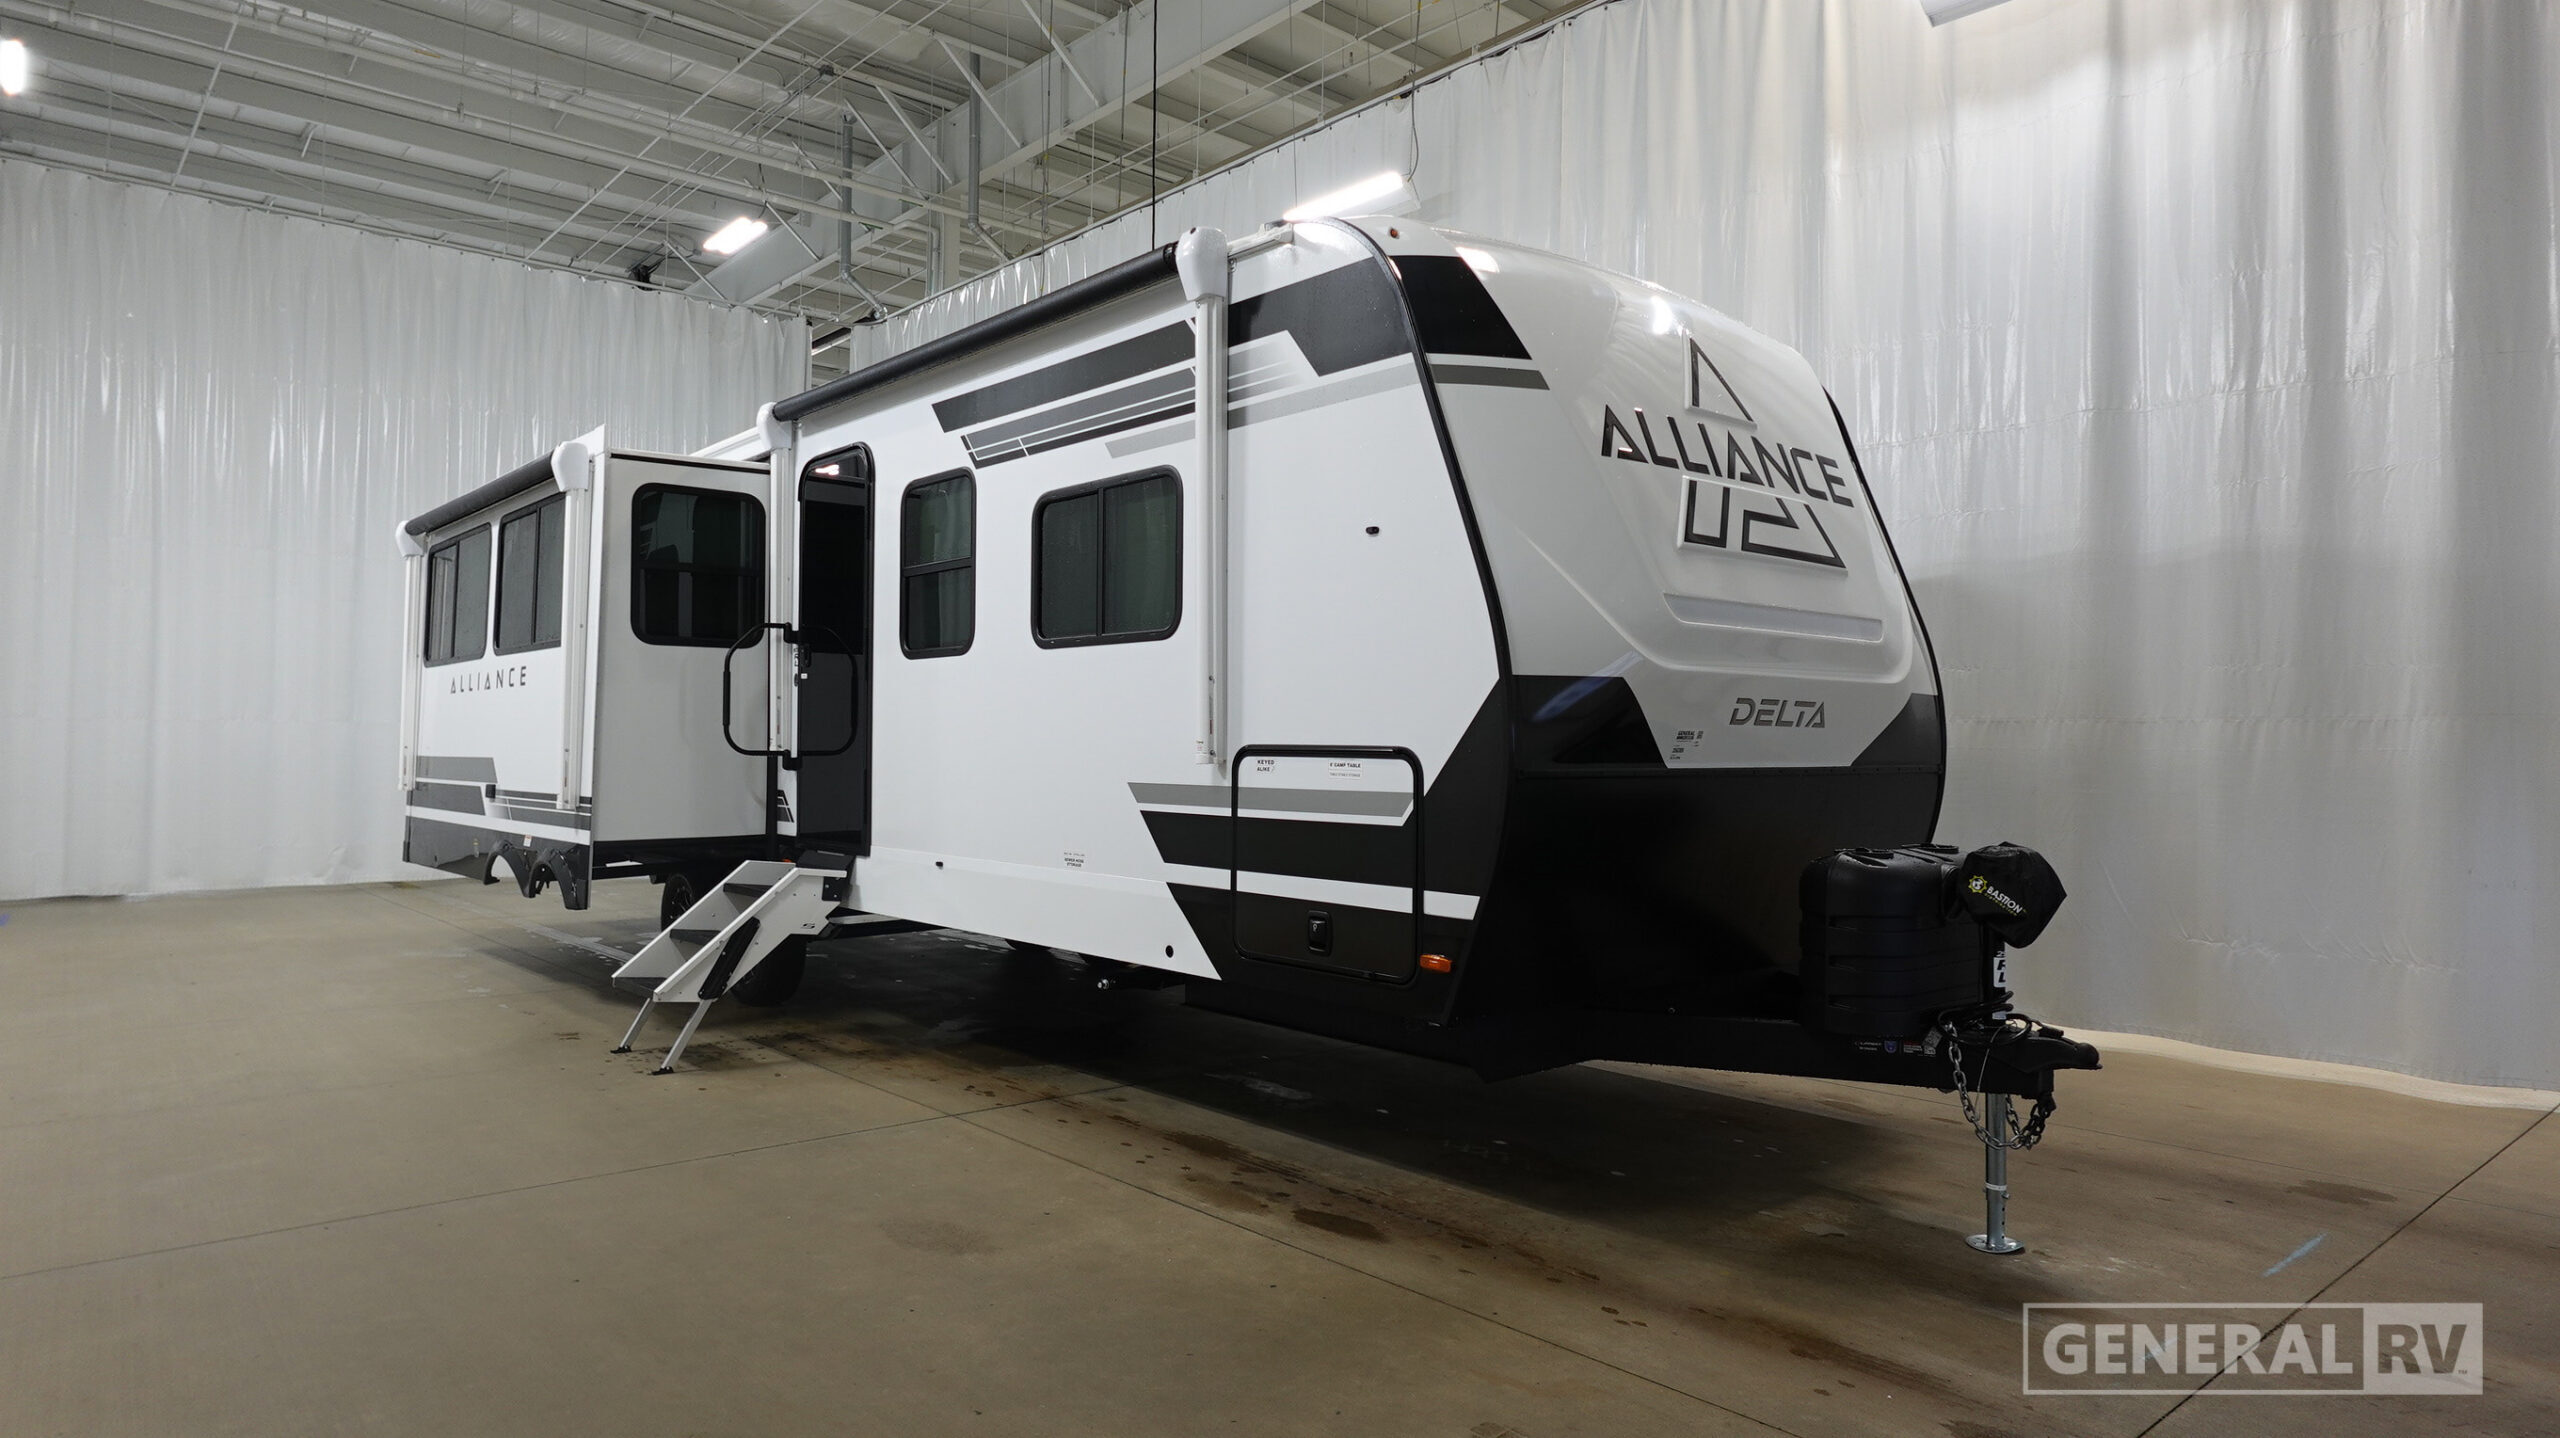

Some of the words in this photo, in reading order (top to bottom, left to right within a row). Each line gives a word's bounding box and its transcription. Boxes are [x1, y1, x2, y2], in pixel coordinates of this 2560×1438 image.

[1601, 404, 1854, 508] ALLIANCE
[450, 666, 527, 694] ALLIANCE
[1729, 697, 1825, 728] DELTA
[1986, 885, 2023, 914] BASTION
